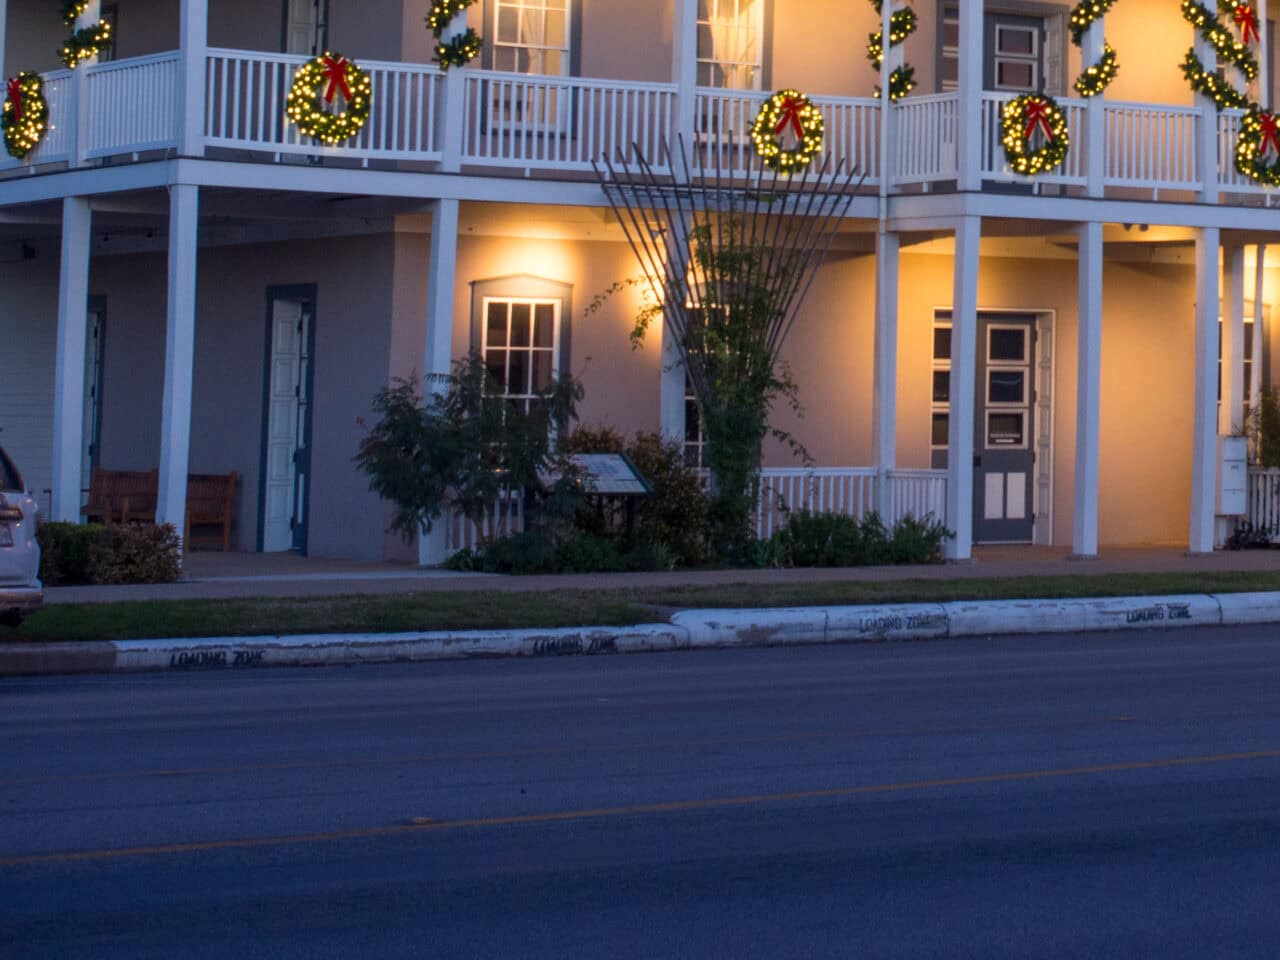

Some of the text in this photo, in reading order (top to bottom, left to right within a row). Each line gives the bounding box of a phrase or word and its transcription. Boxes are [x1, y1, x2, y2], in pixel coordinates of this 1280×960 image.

[1126, 604, 1192, 622] LOADING ZONE
[858, 617, 902, 633] LOADING
[171, 650, 226, 668] LOADING
